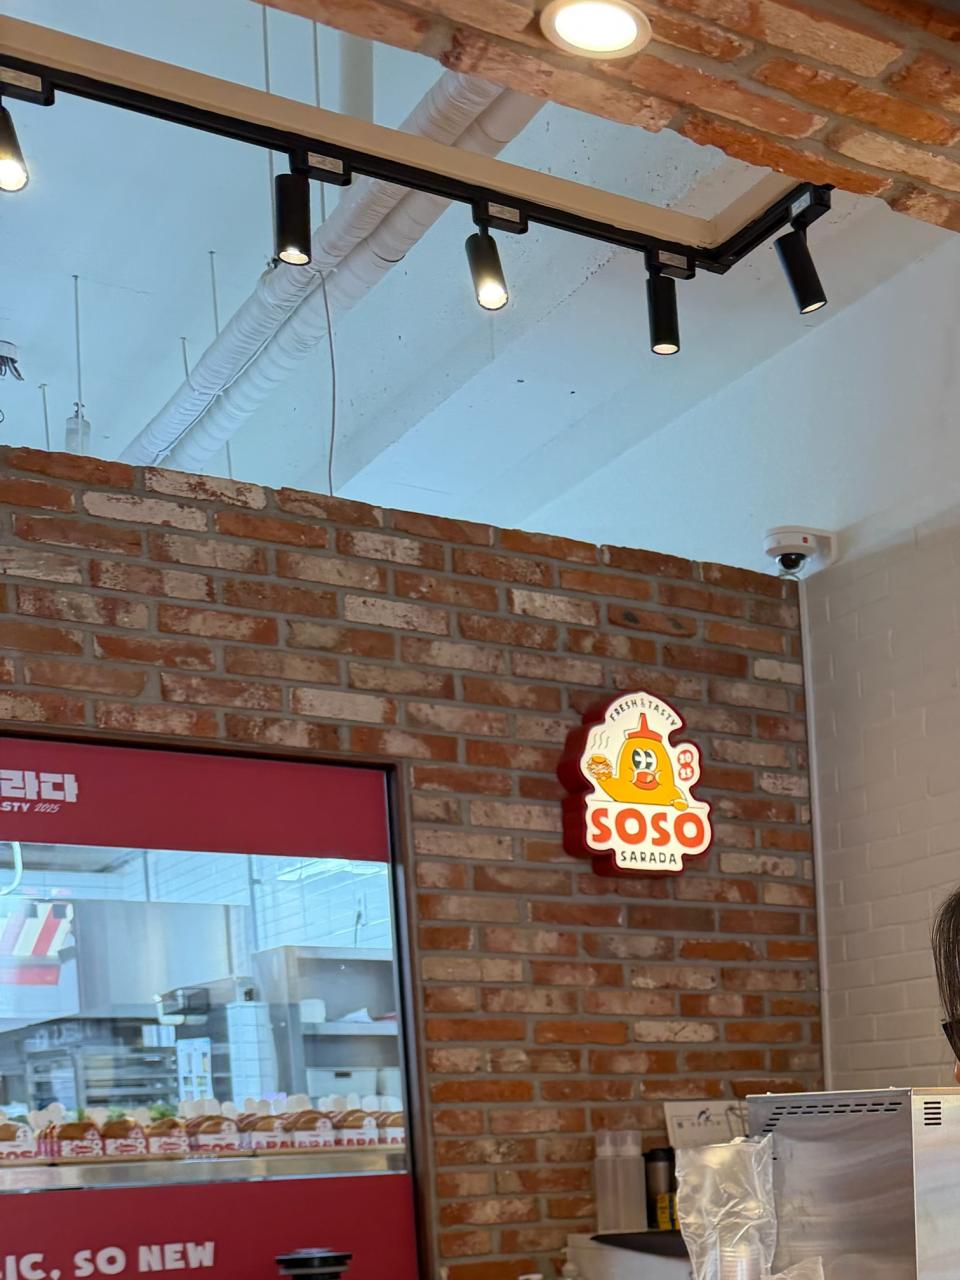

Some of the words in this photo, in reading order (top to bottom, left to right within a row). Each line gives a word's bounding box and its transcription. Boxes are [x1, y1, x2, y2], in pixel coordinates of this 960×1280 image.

[609, 699, 638, 722] FRESH
[648, 701, 678, 727] TASTY
[0, 769, 78, 803] 라다
[591, 807, 705, 849] SOSO
[620, 850, 678, 866] SARADA
[73, 1246, 126, 1277] SO
[138, 1241, 215, 1272] NEW
